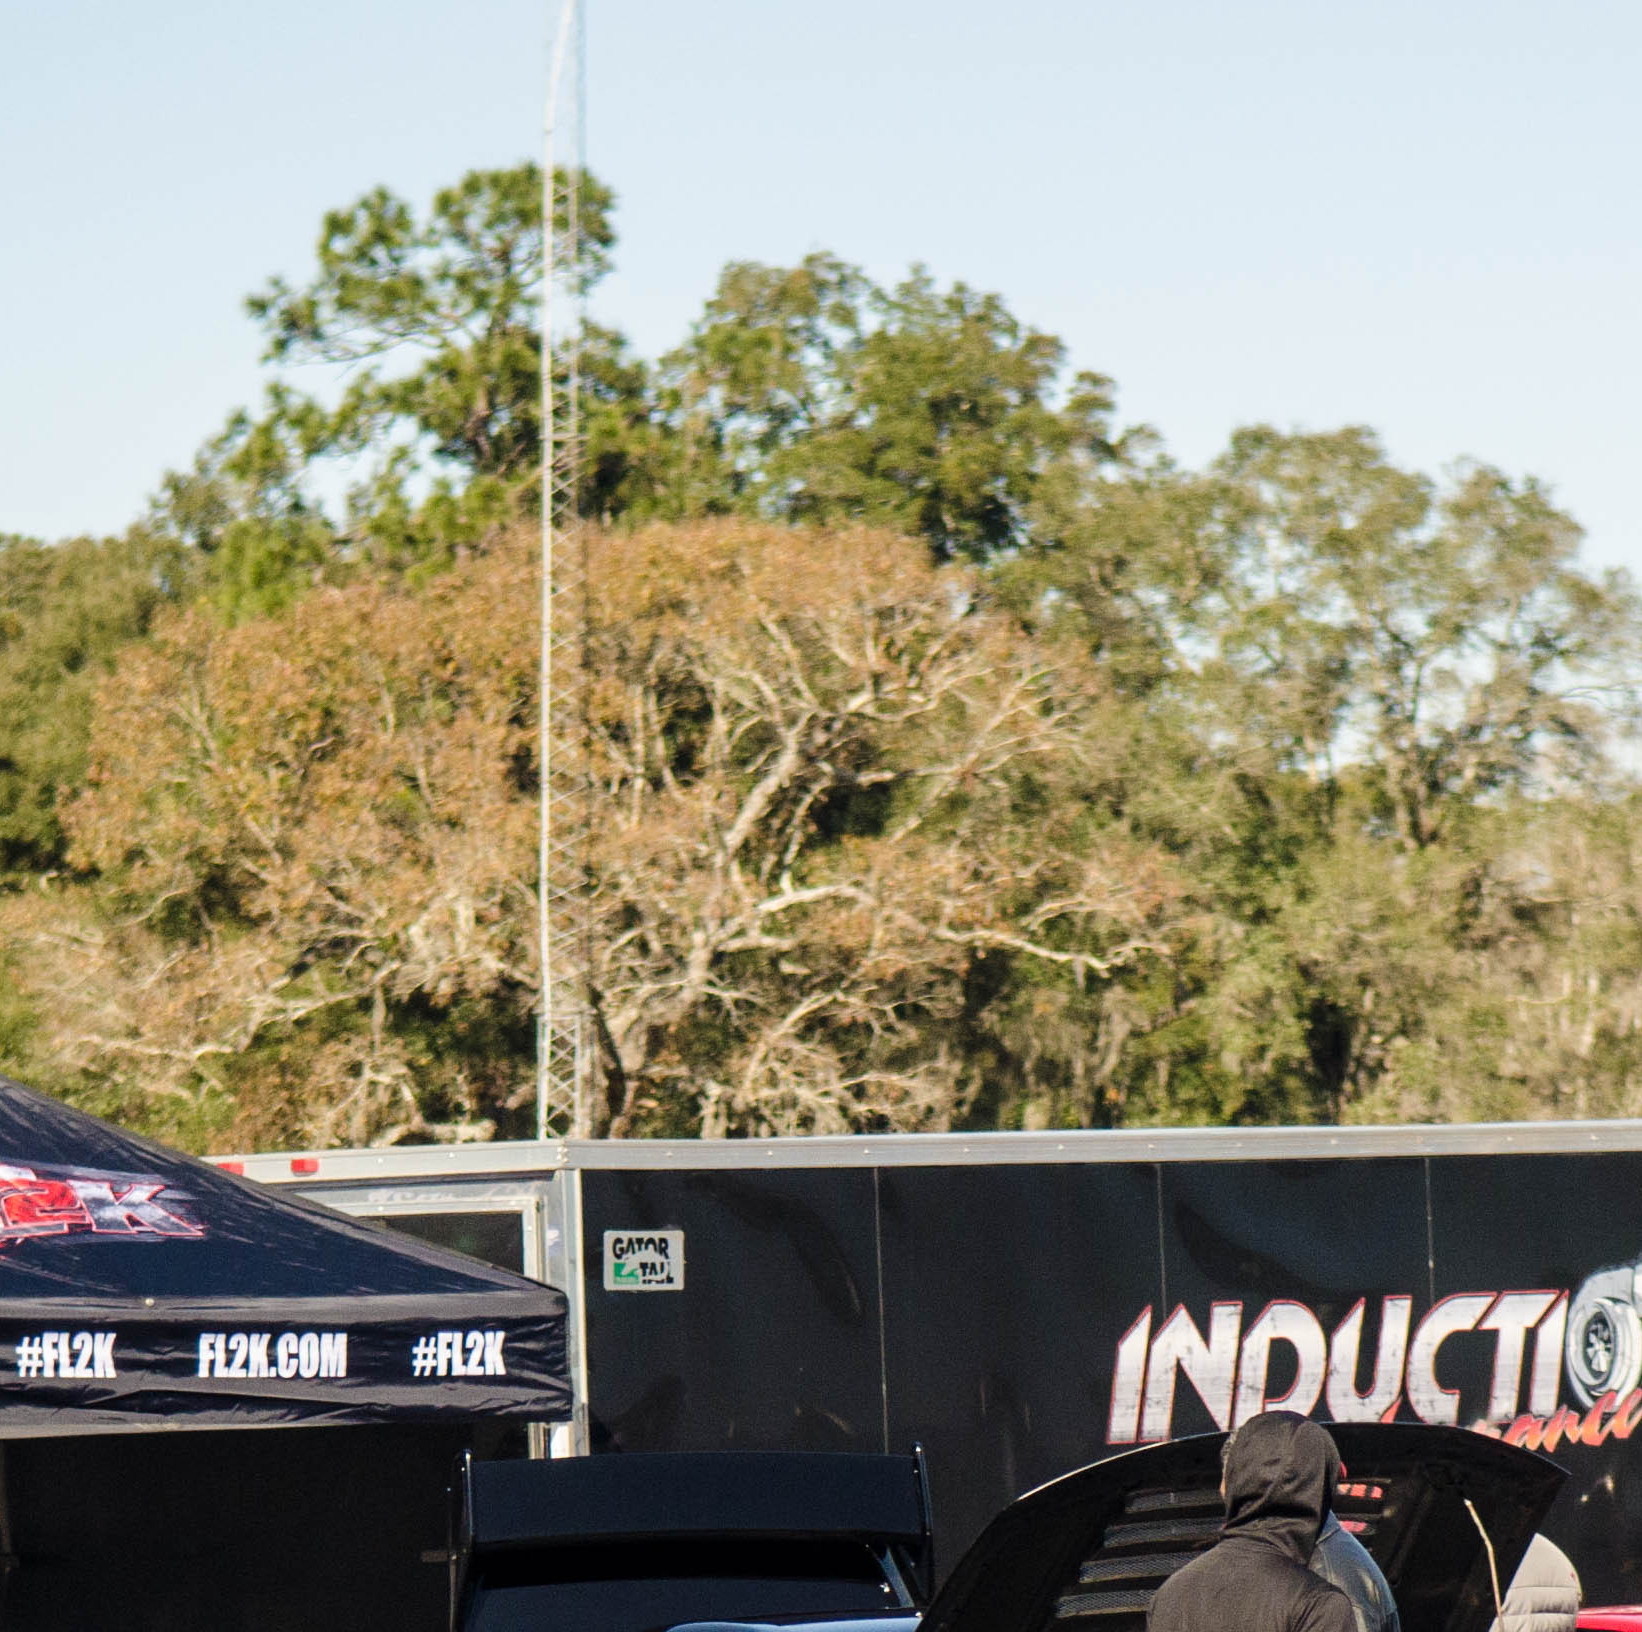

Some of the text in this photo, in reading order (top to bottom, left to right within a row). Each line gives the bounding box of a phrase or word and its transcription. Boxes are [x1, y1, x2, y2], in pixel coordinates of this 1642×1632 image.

[612, 1236, 670, 1260] GATOR
[15, 1331, 117, 1379] #FL2K
[198, 1331, 348, 1379] FL2K.COM
[411, 1330, 506, 1377] #FL2K
